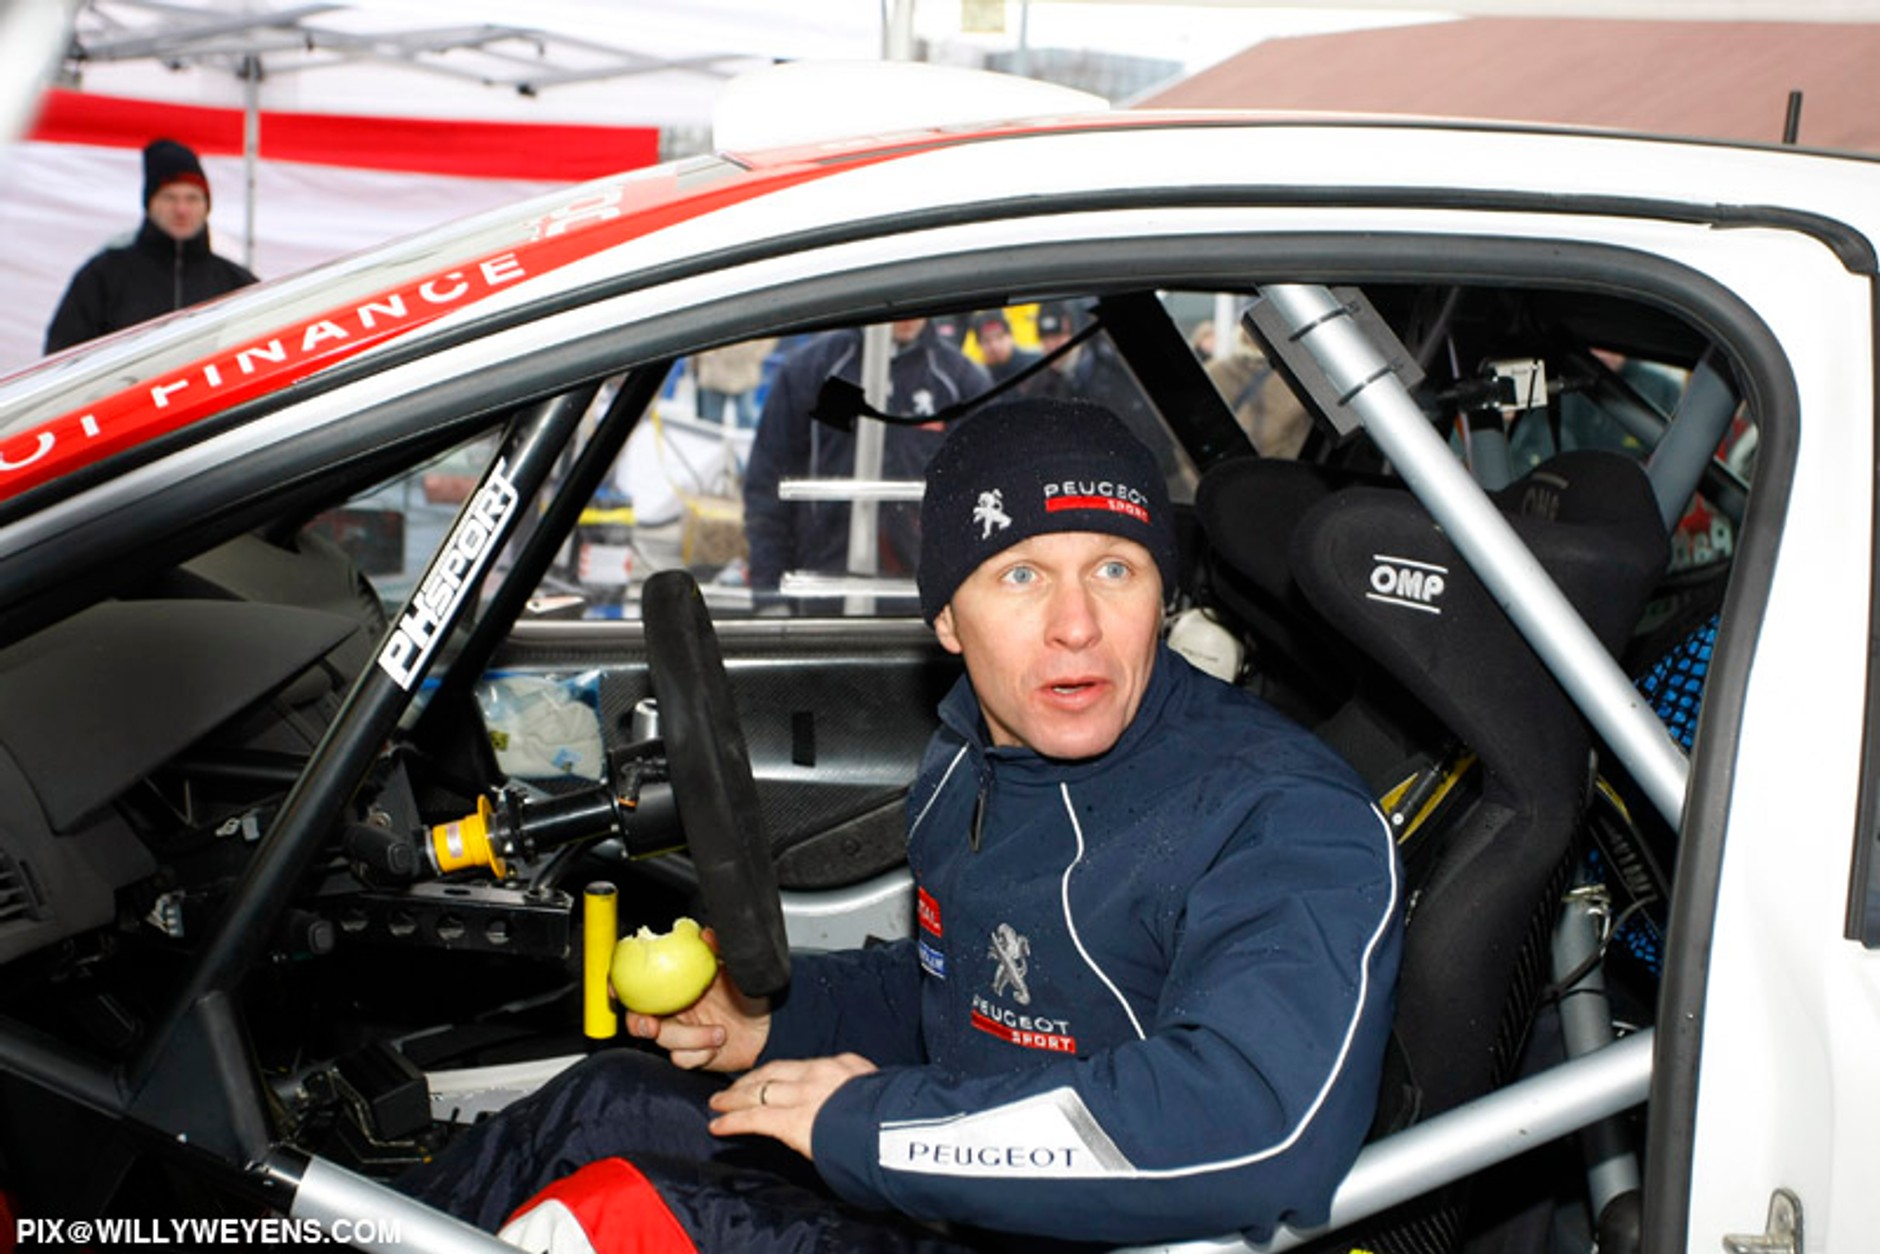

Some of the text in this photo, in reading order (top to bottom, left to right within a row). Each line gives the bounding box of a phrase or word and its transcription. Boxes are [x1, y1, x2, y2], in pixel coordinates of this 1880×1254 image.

[150, 252, 526, 408] FINANCE
[1370, 565, 1445, 602] OMP
[973, 994, 1070, 1036] PEUGEOT
[1012, 1031, 1072, 1051] SPORT
[908, 1141, 1079, 1168] PEUGEOT
